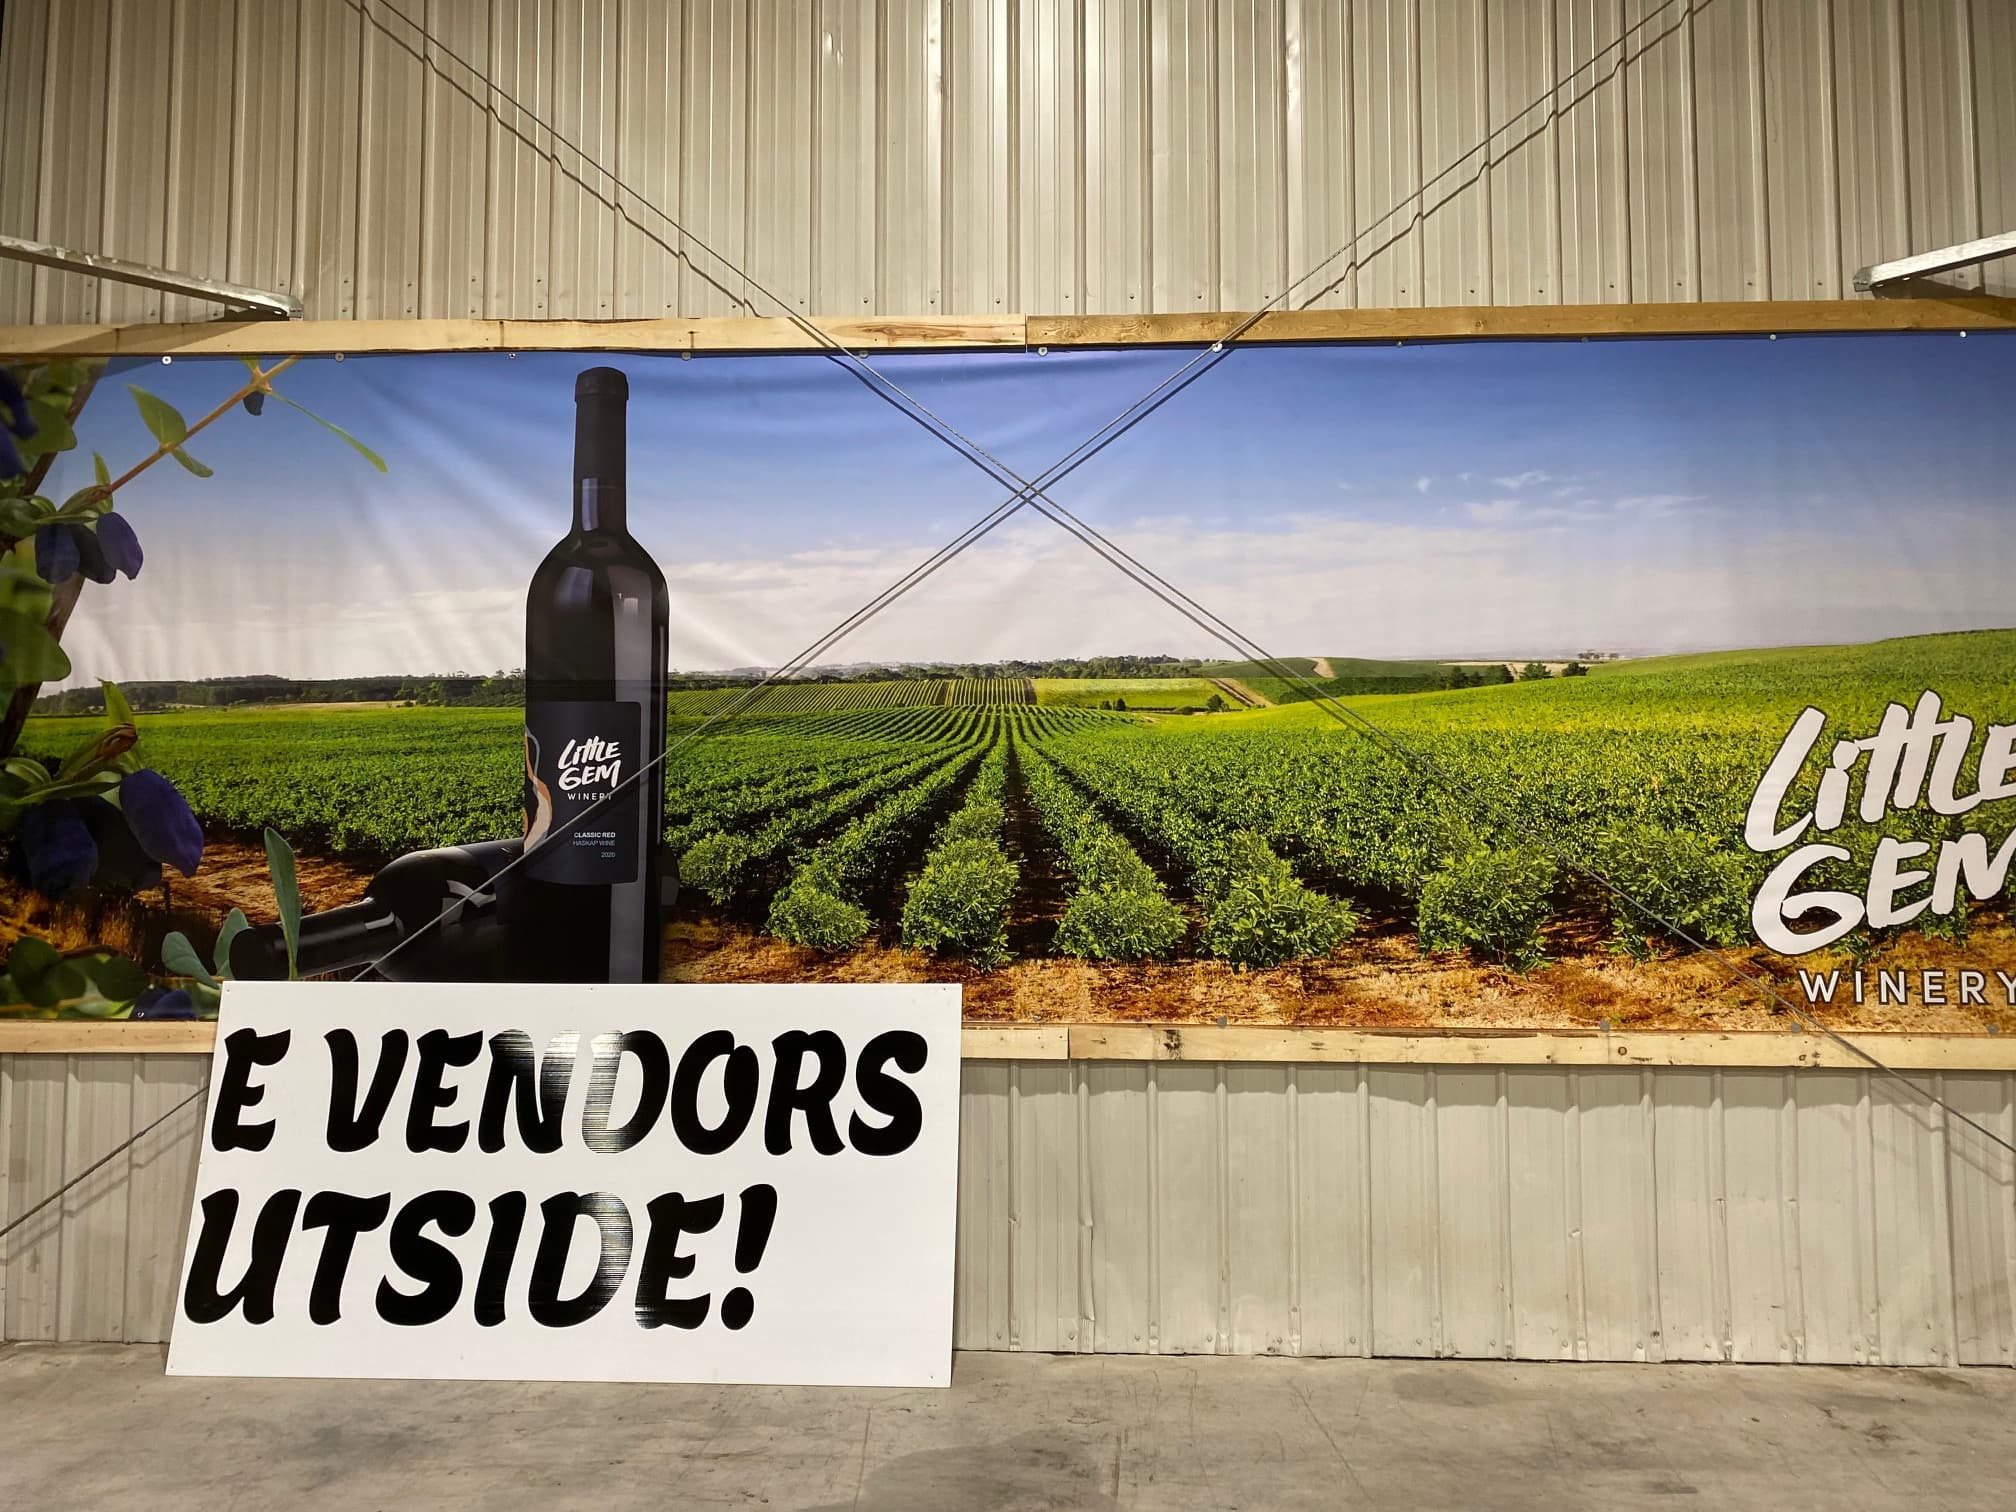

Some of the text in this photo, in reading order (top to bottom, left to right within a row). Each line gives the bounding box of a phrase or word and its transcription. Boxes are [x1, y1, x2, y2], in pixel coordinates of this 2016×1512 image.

[558, 759, 622, 791] GEM
[1799, 970, 2016, 1004] WINERY
[210, 1027, 928, 1157] E VENDORS
[181, 1183, 778, 1331] UTSIDE!
